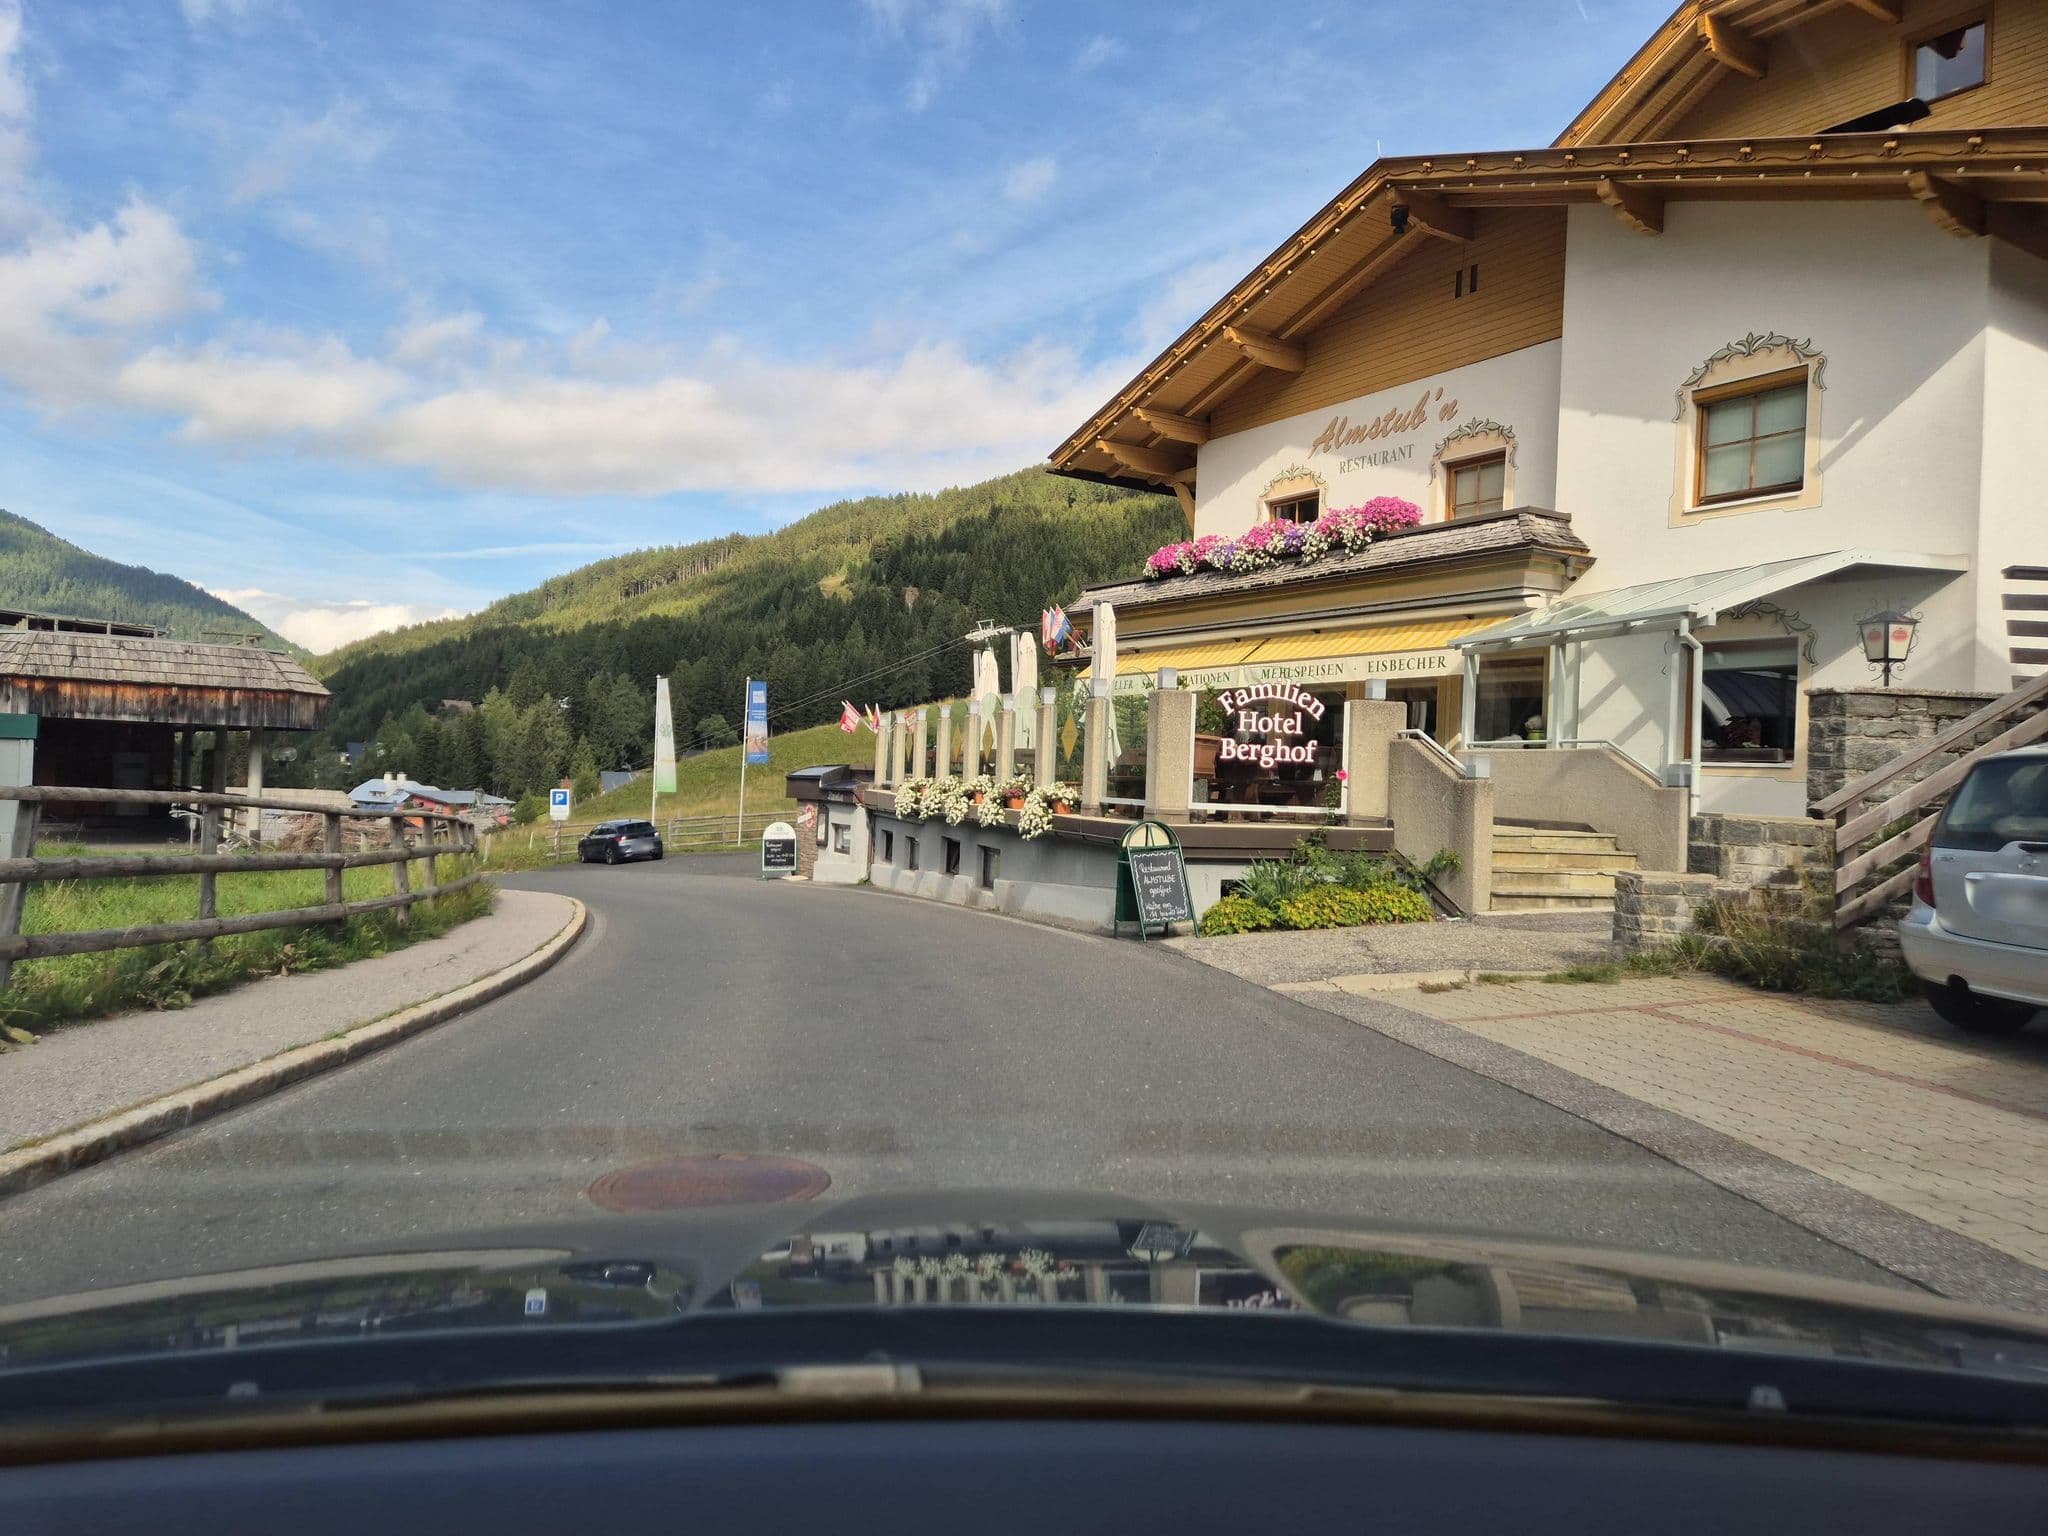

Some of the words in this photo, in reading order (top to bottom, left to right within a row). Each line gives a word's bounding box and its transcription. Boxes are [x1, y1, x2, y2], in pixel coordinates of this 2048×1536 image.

[1308, 387, 1458, 459] Almstub'n
[1339, 444, 1415, 474] RESTAURANT
[1261, 661, 1344, 680] MEHLSPEISEN
[1367, 655, 1447, 673] EISBECHER
[1217, 677, 1326, 721] Familien
[1237, 711, 1303, 735] Hotel
[1219, 738, 1318, 768] Berghof
[555, 793, 564, 804] P
